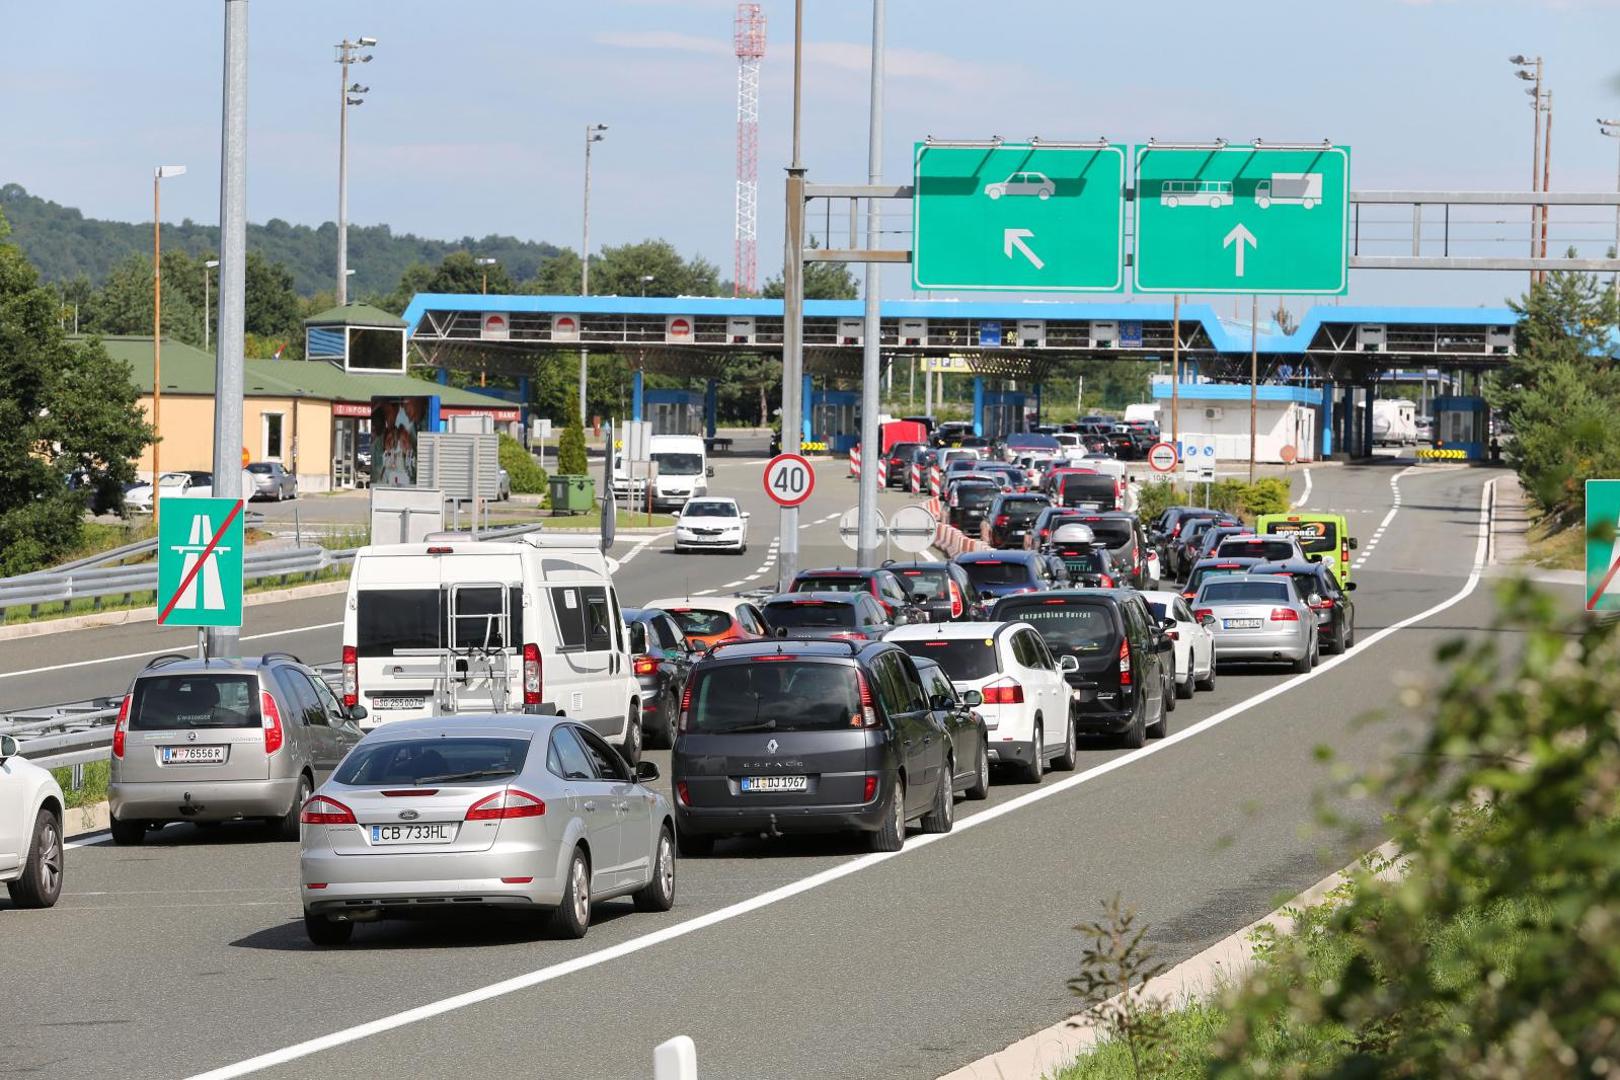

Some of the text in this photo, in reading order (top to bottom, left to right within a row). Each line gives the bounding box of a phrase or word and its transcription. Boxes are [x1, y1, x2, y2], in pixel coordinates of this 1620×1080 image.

[774, 467, 804, 493] 40
[380, 698, 418, 707] SG 255007
[373, 715, 382, 723] CH
[172, 749, 178, 758] W
[768, 777, 780, 787] DJ
[782, 777, 805, 787] 1967
[381, 825, 447, 840] CB 733HL
